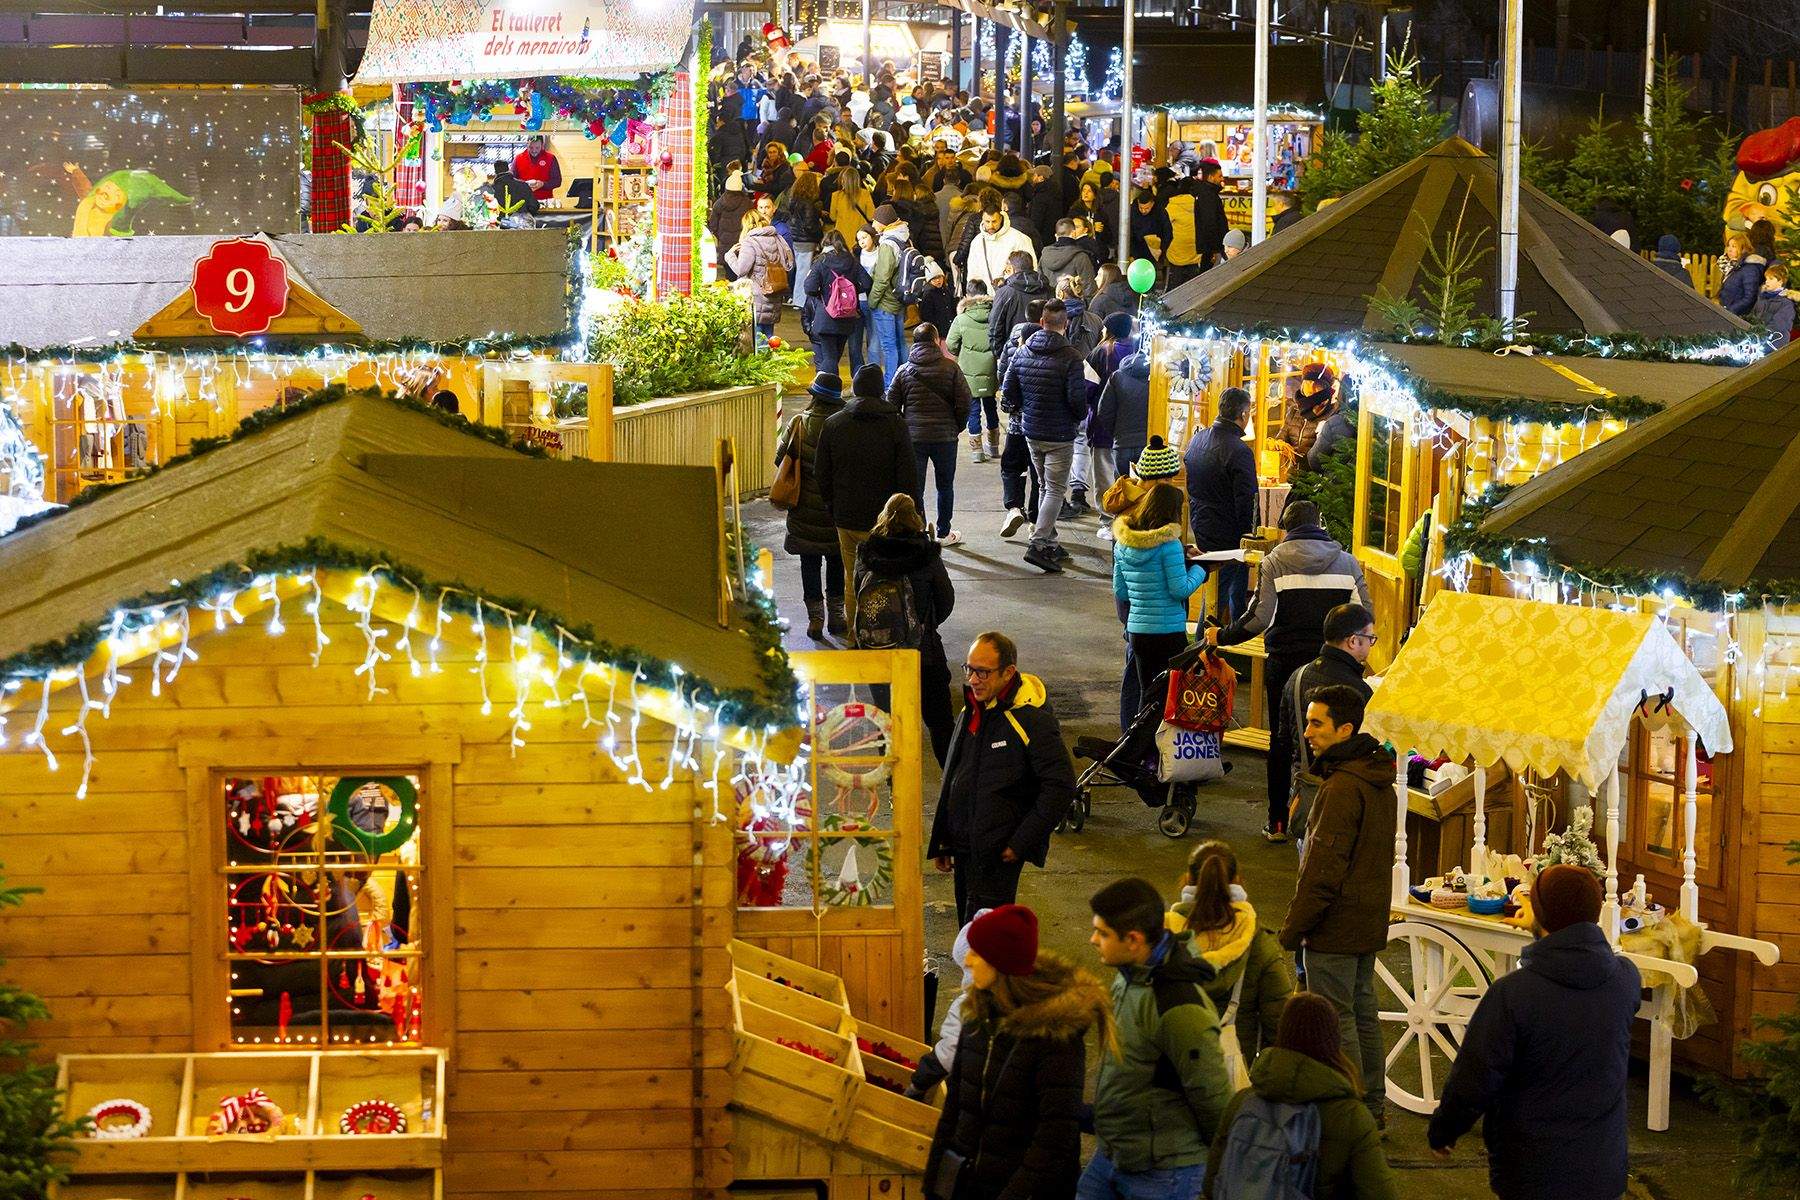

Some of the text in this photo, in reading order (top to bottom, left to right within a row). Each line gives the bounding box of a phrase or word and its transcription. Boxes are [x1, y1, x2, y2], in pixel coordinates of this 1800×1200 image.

[491, 9, 562, 32] El talleret
[484, 35, 514, 56] dels
[225, 268, 255, 313] 9
[1183, 689, 1218, 708] OVS
[1174, 746, 1222, 759] JONES
